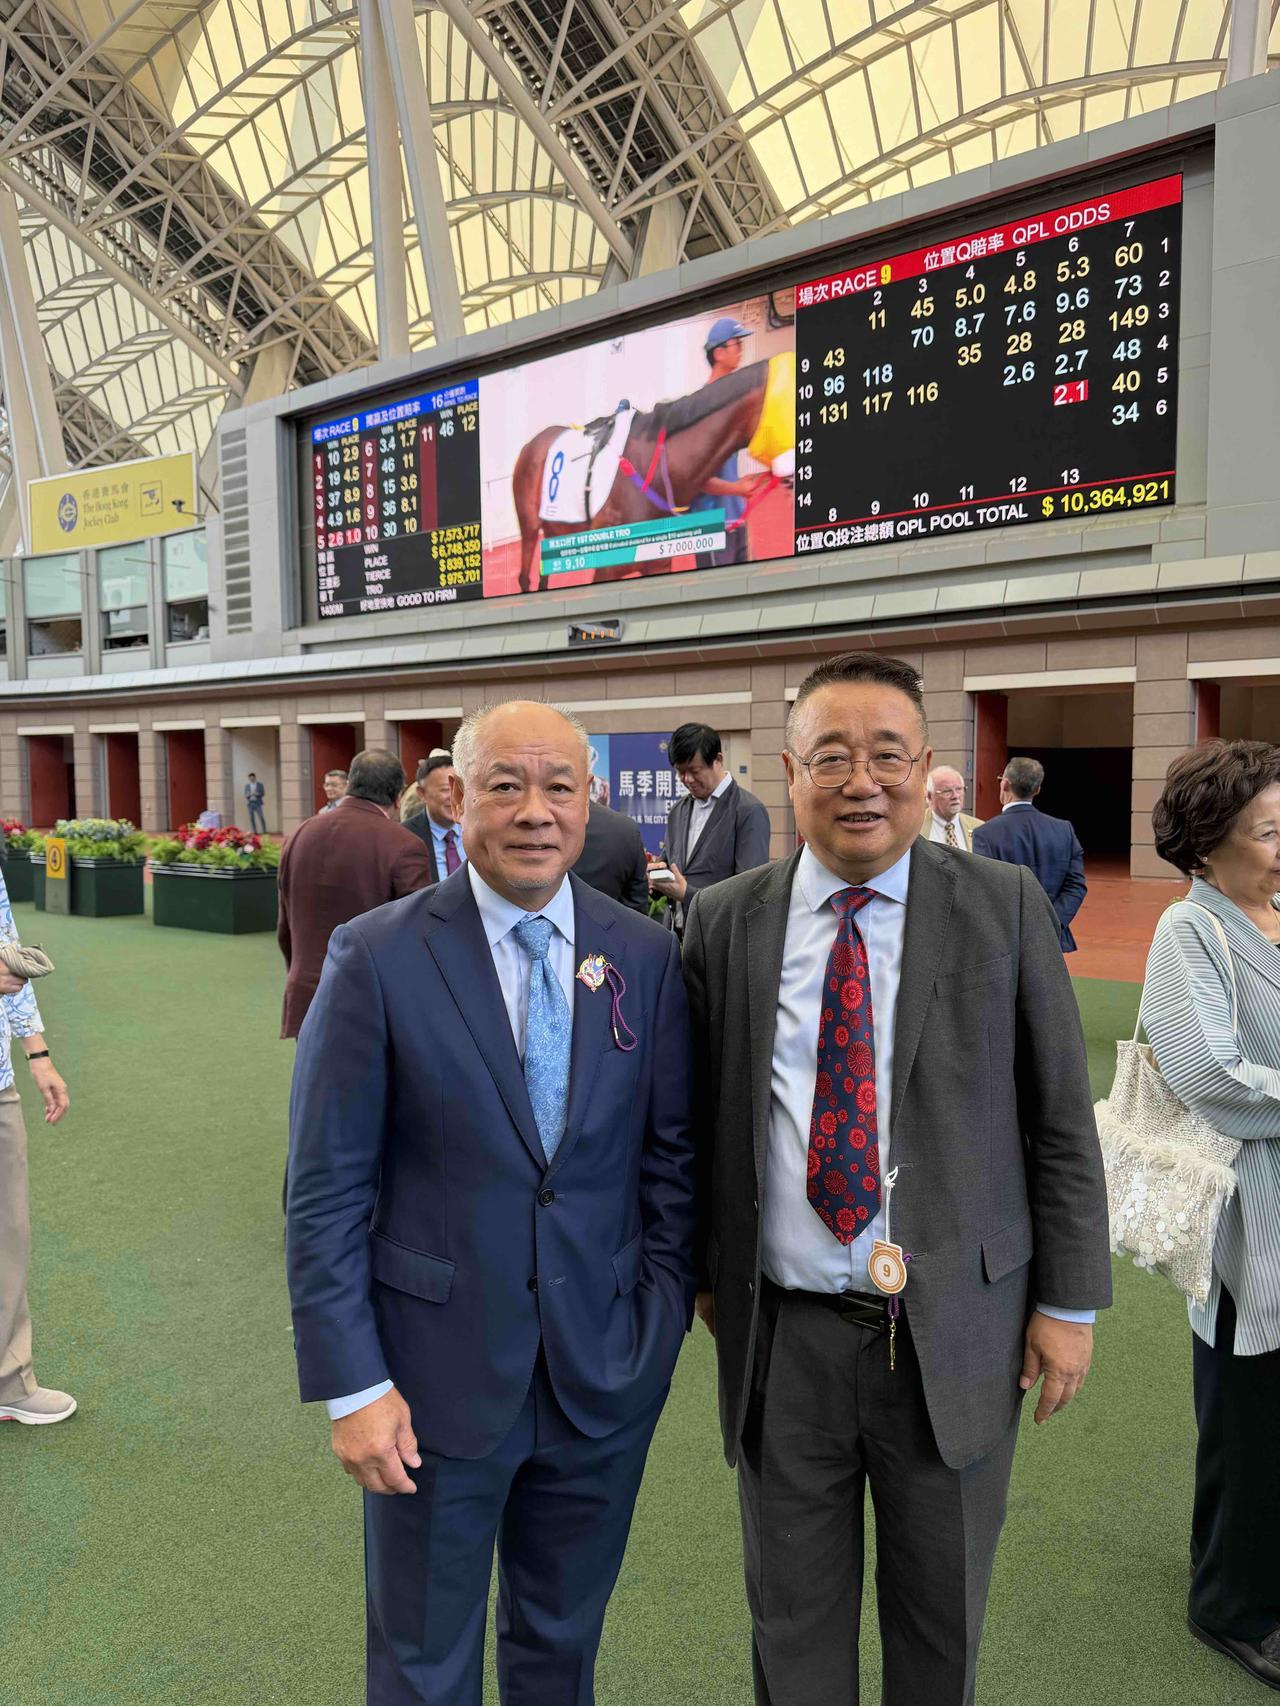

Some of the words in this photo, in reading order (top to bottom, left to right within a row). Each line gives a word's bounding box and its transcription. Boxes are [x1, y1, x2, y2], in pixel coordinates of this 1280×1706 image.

[799, 284, 829, 305] 場次
[831, 271, 877, 296] RACE
[881, 265, 891, 283] 9
[1013, 225, 1049, 244] QPL
[1055, 204, 1110, 232] ODDS
[873, 291, 882, 305] 2
[919, 279, 927, 293] 3
[966, 265, 974, 279] 4
[1016, 252, 1025, 266] 5
[1069, 237, 1079, 252] 6
[1125, 222, 1135, 237] 7
[869, 309, 885, 330] 11
[911, 297, 934, 318] 45
[955, 284, 985, 308] 5.0
[1004, 270, 1036, 294] 4.8
[1057, 256, 1090, 282] 5.3
[1115, 243, 1143, 267] 60
[1161, 238, 1168, 253] 1
[802, 359, 810, 373] 9
[823, 348, 845, 369] 43
[911, 326, 934, 348] 70
[955, 313, 985, 337] 8.7
[1005, 301, 1035, 325] 7.6
[1056, 288, 1089, 313] 9.6
[1115, 275, 1142, 299] 73
[1159, 271, 1169, 286] 2
[799, 384, 813, 400] 10
[824, 375, 844, 396] 96
[863, 364, 893, 387] 118
[958, 343, 982, 366] 35
[1007, 332, 1032, 356] 28
[1058, 320, 1085, 344] 28
[1109, 305, 1149, 331] 149
[1158, 303, 1169, 319] 3
[432, 395, 443, 408] 16
[799, 412, 811, 427] 11
[820, 402, 848, 425] 131
[863, 392, 892, 415] 117
[907, 382, 938, 406] 116
[1003, 362, 1035, 386] 2.6
[1055, 350, 1088, 375] 2.7
[1112, 339, 1141, 361] 48
[1157, 336, 1168, 350] 4
[798, 439, 812, 454] 12
[1054, 382, 1085, 405] 2.1
[1112, 371, 1141, 393] 40
[1157, 368, 1168, 383] 5
[316, 456, 321, 469] 1
[328, 452, 340, 466] 10
[343, 448, 359, 462] 2.9
[365, 442, 372, 456] 6
[380, 436, 395, 453] 3.4
[400, 431, 416, 447] 1.7
[422, 426, 432, 442] 11
[440, 421, 454, 437] 46
[462, 416, 475, 432] 12
[798, 466, 812, 480] 13
[1112, 402, 1139, 425] 34
[1156, 400, 1167, 415] 6
[316, 477, 323, 489] 2
[328, 471, 340, 486] 19
[343, 468, 359, 482] 4.5
[366, 463, 373, 477] 7
[382, 458, 395, 473] 46
[403, 453, 414, 468] 11
[316, 495, 323, 509] 3
[328, 493, 341, 507] 37
[383, 480, 395, 494] 15
[400, 474, 417, 491] 3.6
[549, 451, 564, 503] 8
[829, 508, 837, 522] 8
[871, 501, 880, 515] 9
[913, 493, 929, 508] 10
[960, 485, 974, 500] 11
[1009, 477, 1027, 493] 12
[1061, 468, 1079, 485] 13
[105, 513, 119, 524] Club
[112, 499, 129, 510] Kong
[317, 516, 323, 529] 4
[327, 512, 343, 526] 4.9
[346, 507, 361, 523] 1.6
[367, 505, 374, 519] 9
[383, 501, 396, 516] 36
[401, 496, 417, 513] 8.1
[798, 493, 811, 508] 14
[897, 520, 926, 536] QPL
[930, 515, 973, 531] POOL
[977, 503, 1028, 524] TOTAL
[1061, 480, 1169, 513] 10,364,921
[318, 536, 324, 549] 5
[366, 525, 378, 540] 10
[383, 521, 397, 537] 30
[404, 518, 416, 533] 10
[668, 537, 713, 553] 7,000,000
[397, 593, 421, 607] GOOD
[424, 591, 434, 603] TO
[436, 588, 457, 601] FIRM
[883, 1264, 890, 1277] 9
